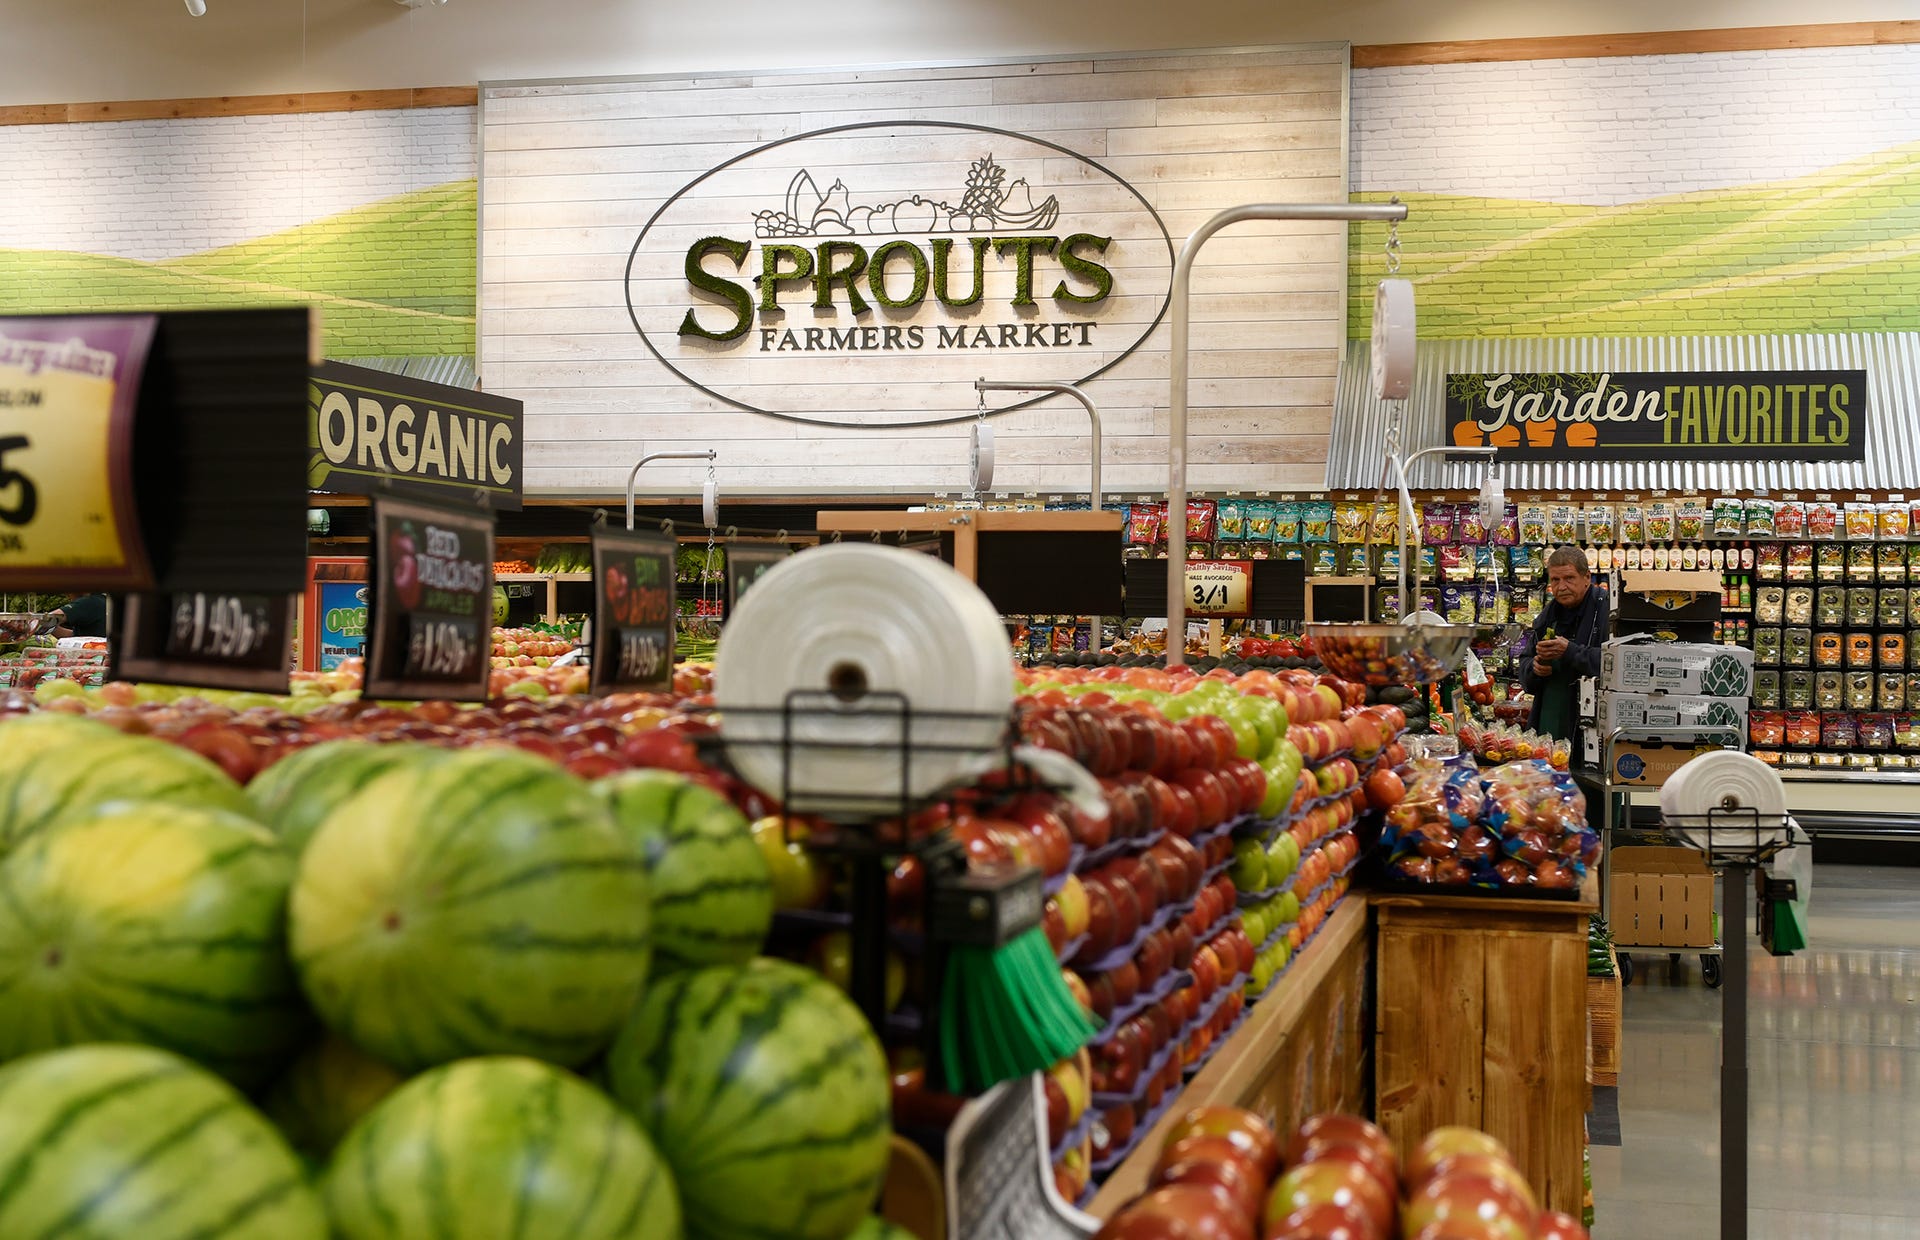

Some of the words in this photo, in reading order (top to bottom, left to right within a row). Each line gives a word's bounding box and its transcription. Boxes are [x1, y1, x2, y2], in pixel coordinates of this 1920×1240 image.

[677, 232, 1112, 342] SPROUTS
[760, 326, 924, 352] FARMERS
[937, 321, 1097, 349] MARKET
[319, 390, 513, 486] ORGANIC
[1476, 373, 1669, 432] Garden
[1664, 383, 1850, 444] FAVORITES
[1212, 563, 1242, 573] Savings
